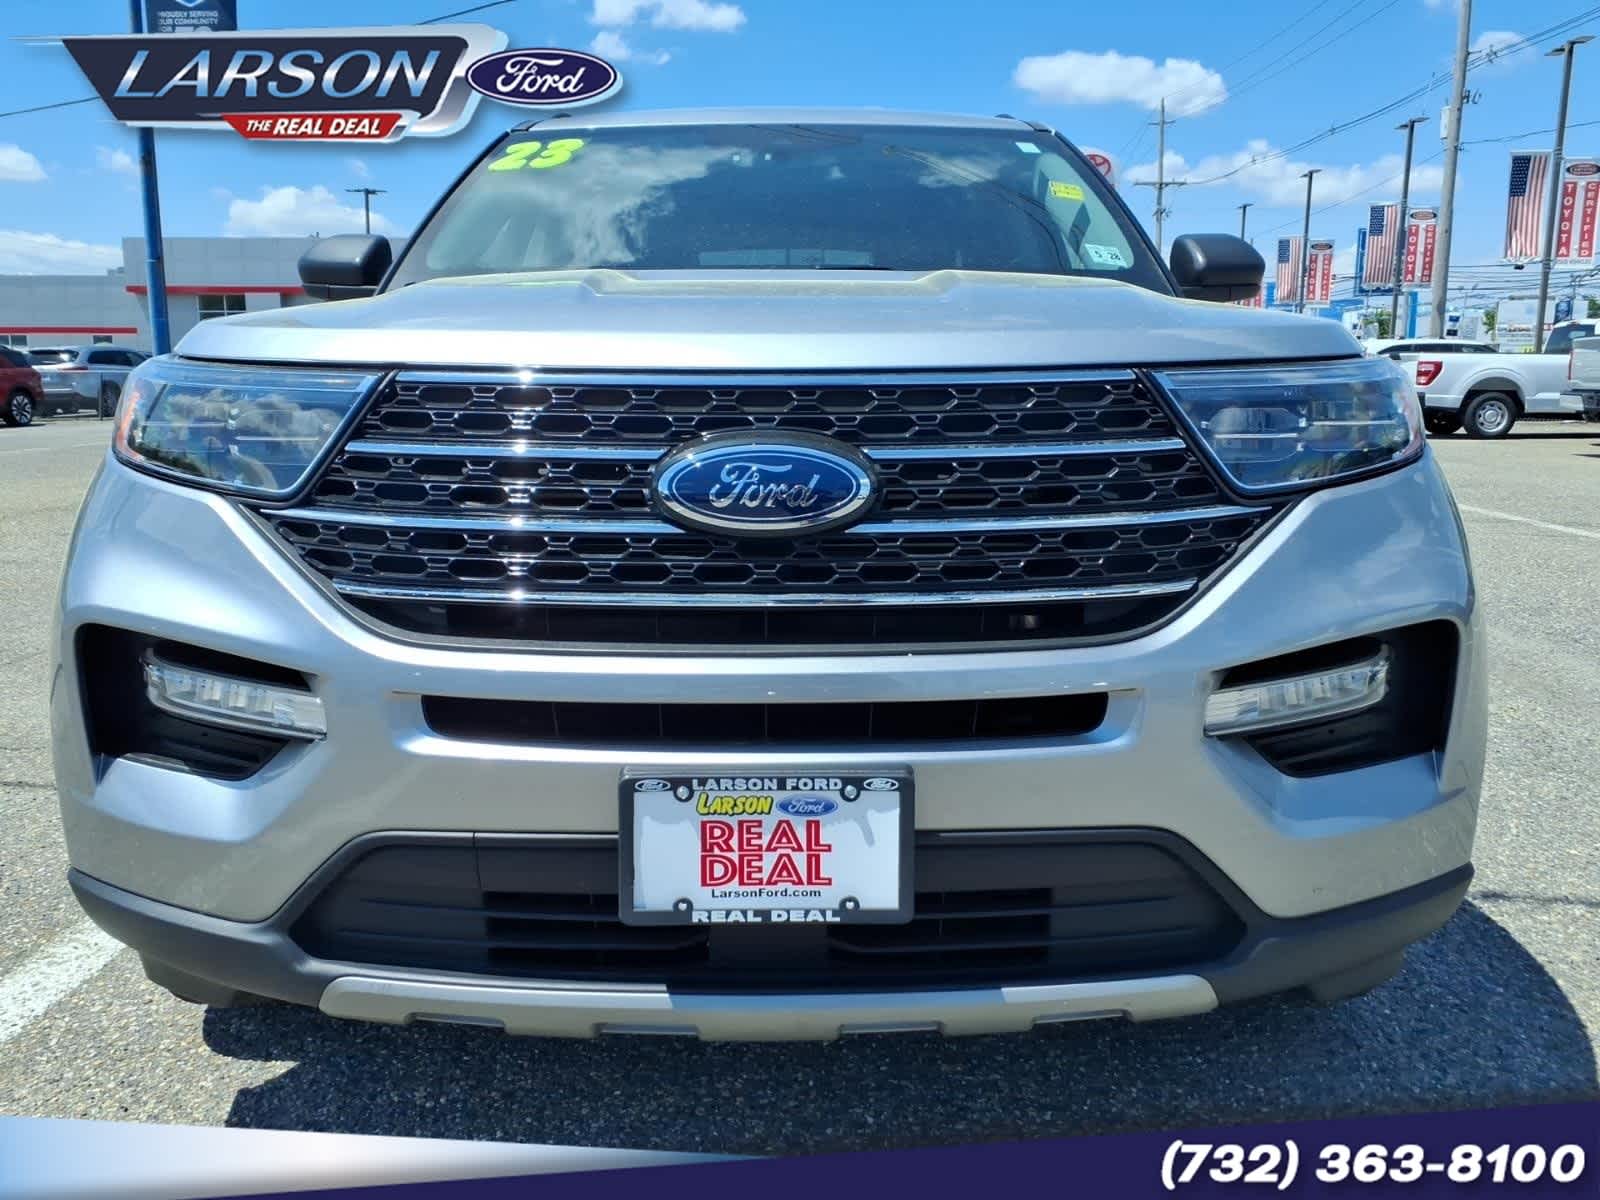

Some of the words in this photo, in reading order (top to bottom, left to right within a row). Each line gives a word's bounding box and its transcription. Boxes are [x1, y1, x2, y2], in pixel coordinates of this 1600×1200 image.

[488, 138, 585, 171] 23
[1558, 183, 1574, 255] TOYOTA
[1580, 183, 1597, 256] CERTIFIED
[1406, 226, 1417, 281] TOYOTA
[709, 462, 819, 508] Ford
[692, 778, 779, 791] LARSON
[786, 777, 843, 791] FORD
[700, 820, 832, 852] REAL
[700, 853, 832, 887] DEAL
[711, 888, 822, 898] LarsonFord.com
[692, 910, 763, 923] REAL
[771, 910, 841, 923] DEAL
